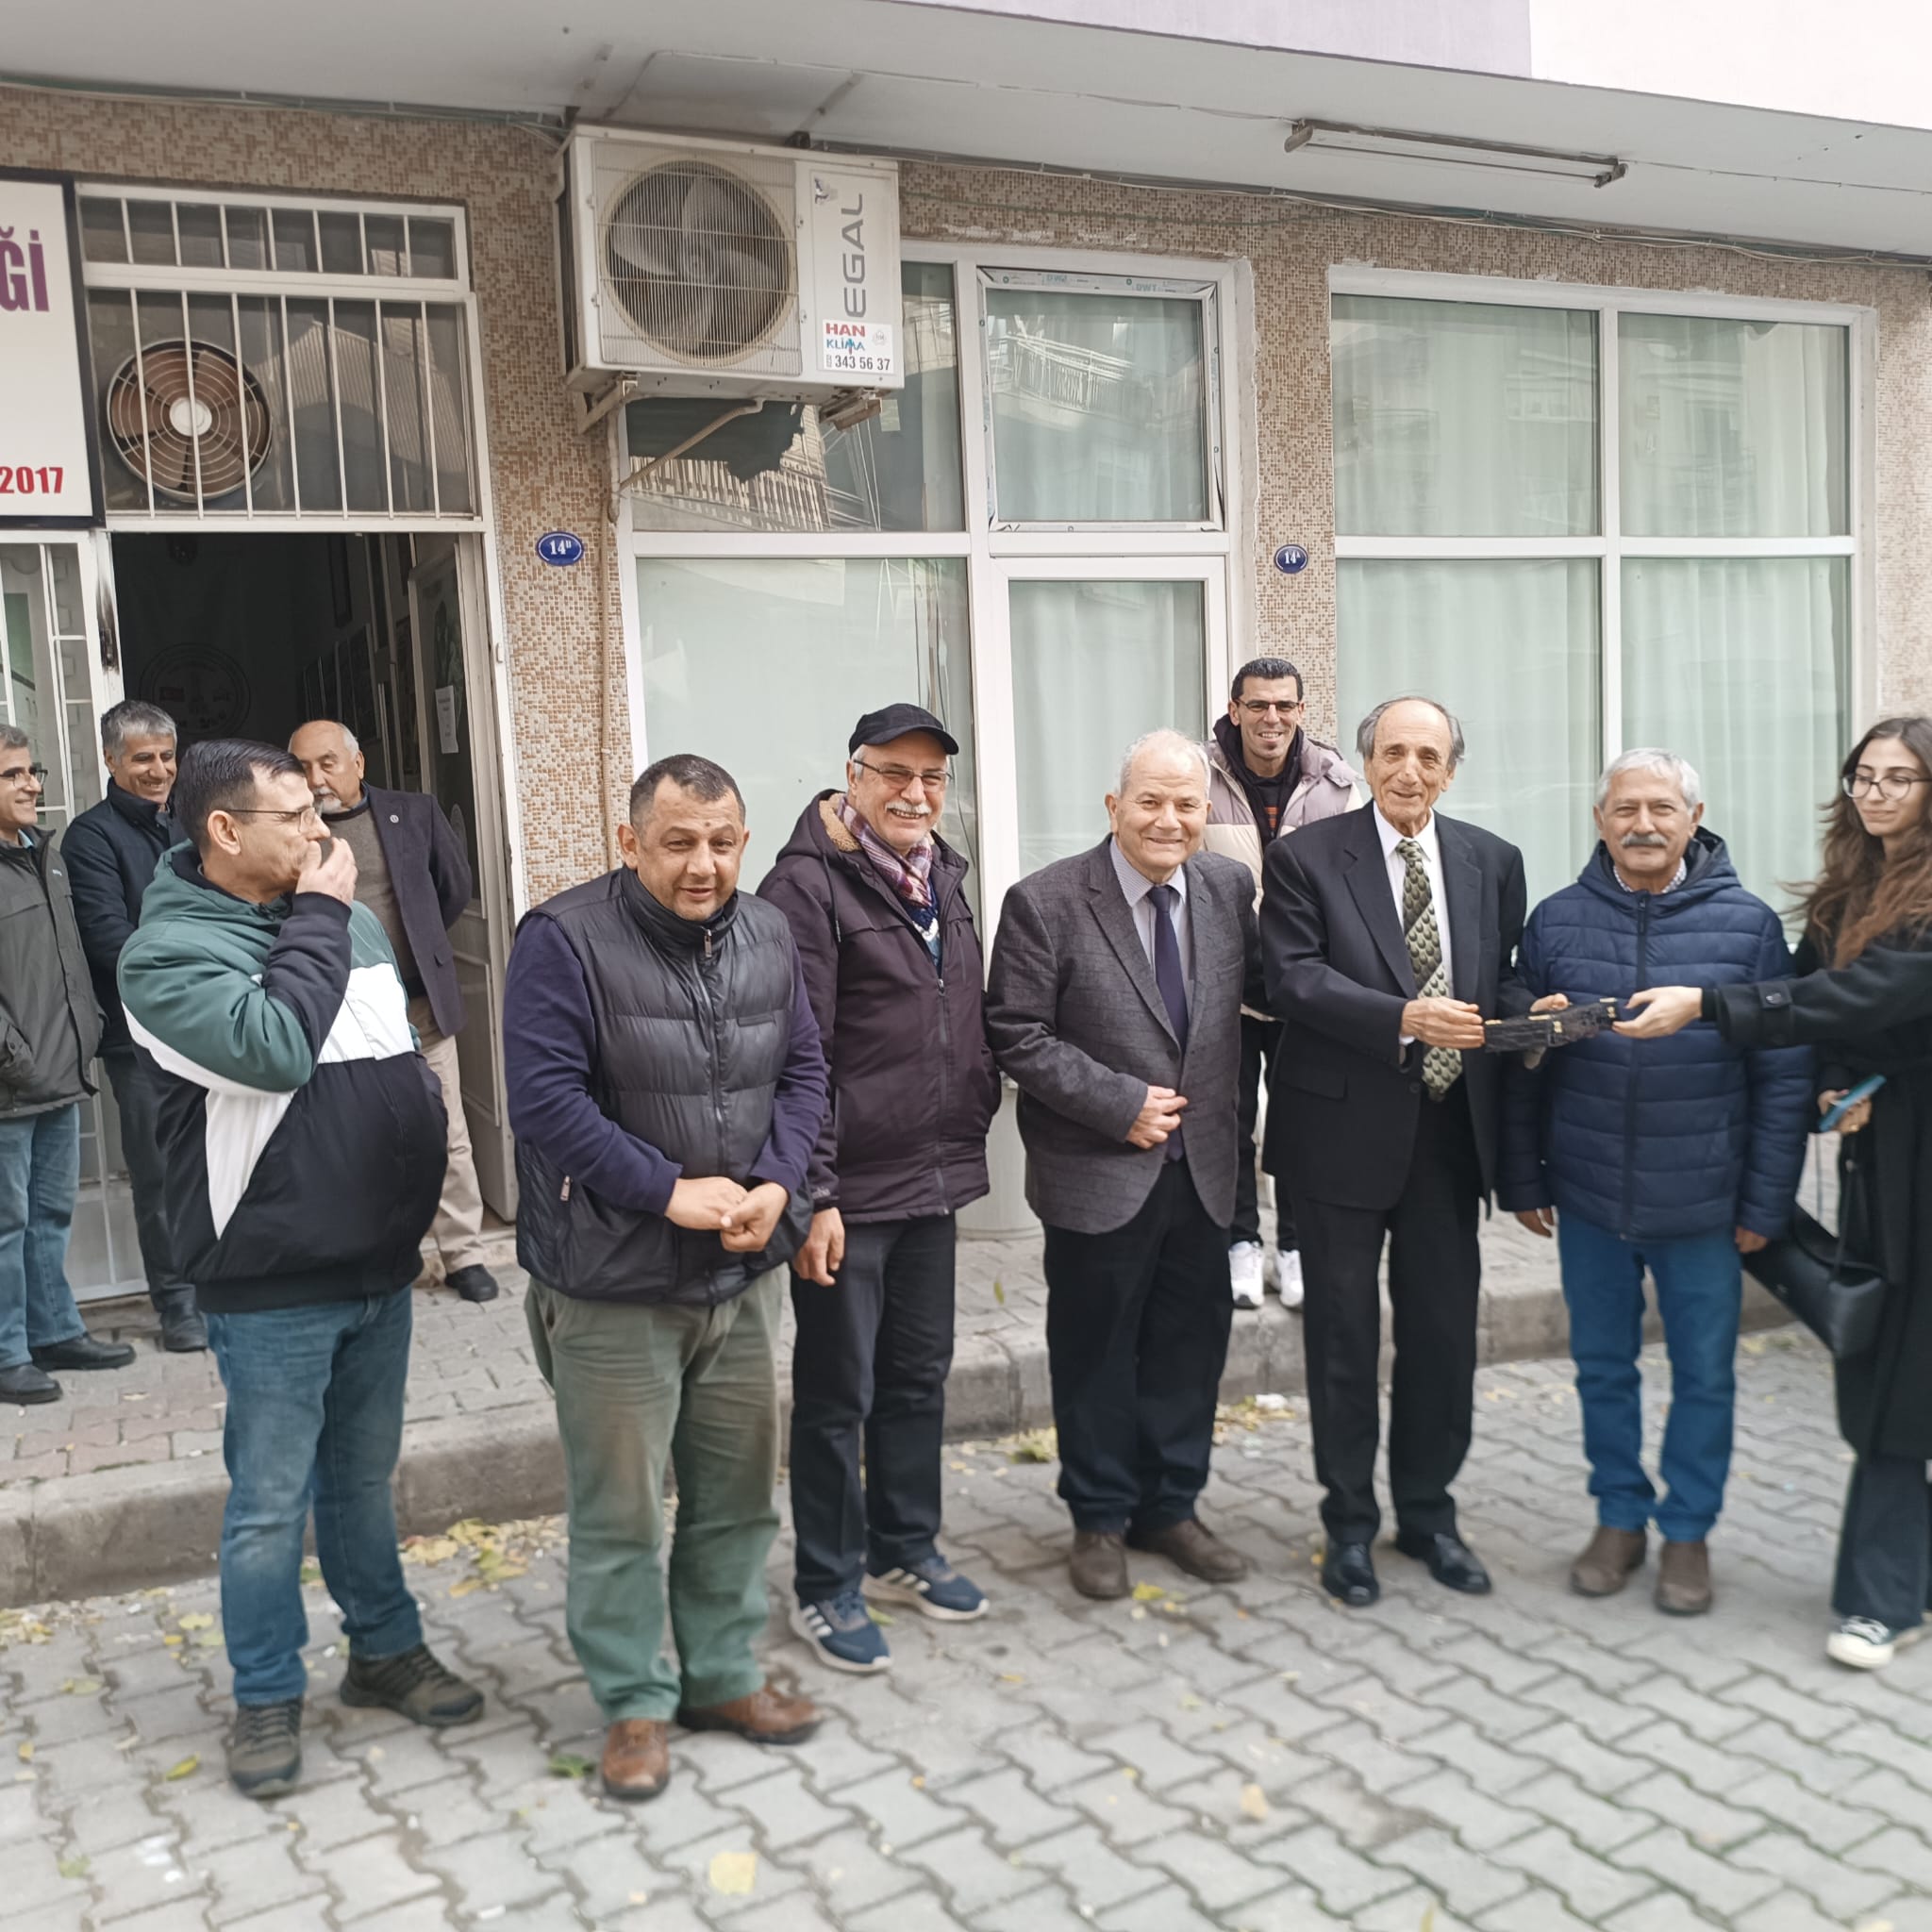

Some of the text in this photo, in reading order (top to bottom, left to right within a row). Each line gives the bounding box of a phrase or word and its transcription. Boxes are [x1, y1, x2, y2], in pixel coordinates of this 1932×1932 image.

[825, 323, 866, 338] HAN
[835, 355, 857, 369] 343
[859, 357, 874, 370] 56
[876, 358, 891, 371] 37
[0, 466, 63, 494] 2017
